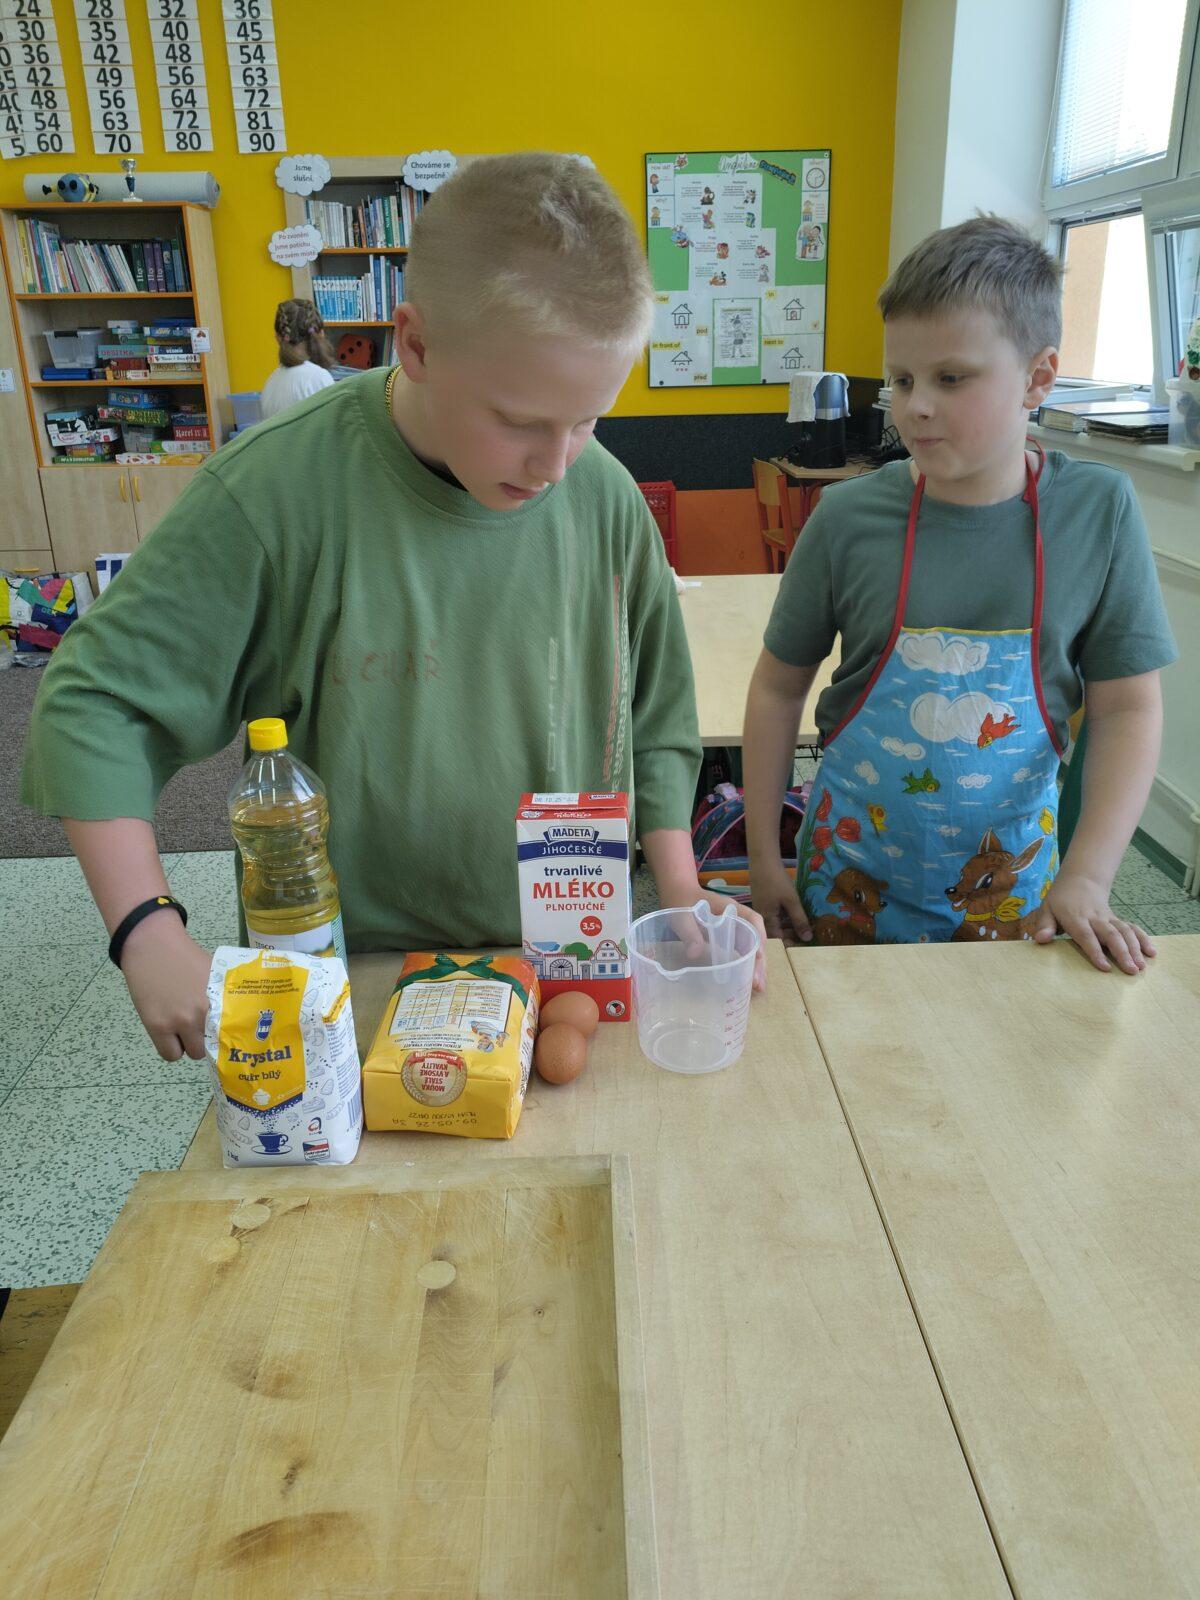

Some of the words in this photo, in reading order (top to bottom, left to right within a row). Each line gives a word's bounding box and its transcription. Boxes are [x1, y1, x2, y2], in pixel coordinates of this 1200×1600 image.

[15, 0, 41, 17] 24
[86, 0, 113, 19] 28
[159, 0, 186, 18] 32
[234, 0, 260, 19] 36
[18, 20, 44, 42] 30
[90, 21, 116, 41] 35
[163, 21, 188, 41] 40
[237, 22, 262, 41] 45
[0, 46, 11, 67] 0
[23, 44, 49, 64] 36
[94, 44, 120, 64] 42
[166, 43, 191, 63] 48
[240, 45, 265, 64] 54
[27, 67, 53, 88] 42
[97, 68, 122, 87] 49
[169, 66, 194, 85] 56
[243, 67, 267, 86] 63
[31, 90, 57, 109] 48
[100, 90, 125, 109] 56
[171, 89, 196, 109] 64
[244, 89, 270, 107] 72
[35, 112, 60, 131] 54
[103, 112, 128, 130] 63
[173, 110, 199, 129] 72
[247, 111, 272, 130] 81
[37, 133, 62, 152] 60
[105, 134, 131, 153] 70
[176, 132, 201, 150] 80
[250, 133, 275, 151] 90
[552, 828, 591, 838] MADETA
[542, 844, 602, 855] JIHOČESKÉ
[544, 864, 602, 877] trvanlivé
[533, 878, 615, 899] MLÉKO
[545, 901, 605, 911] PLNOTUČNÉ
[229, 1045, 292, 1068] Krystal
[422, 1062, 448, 1070] KVALITY
[238, 1073, 259, 1081] cukr
[262, 1070, 281, 1080] bílý
[422, 1084, 445, 1092] MOUKA
